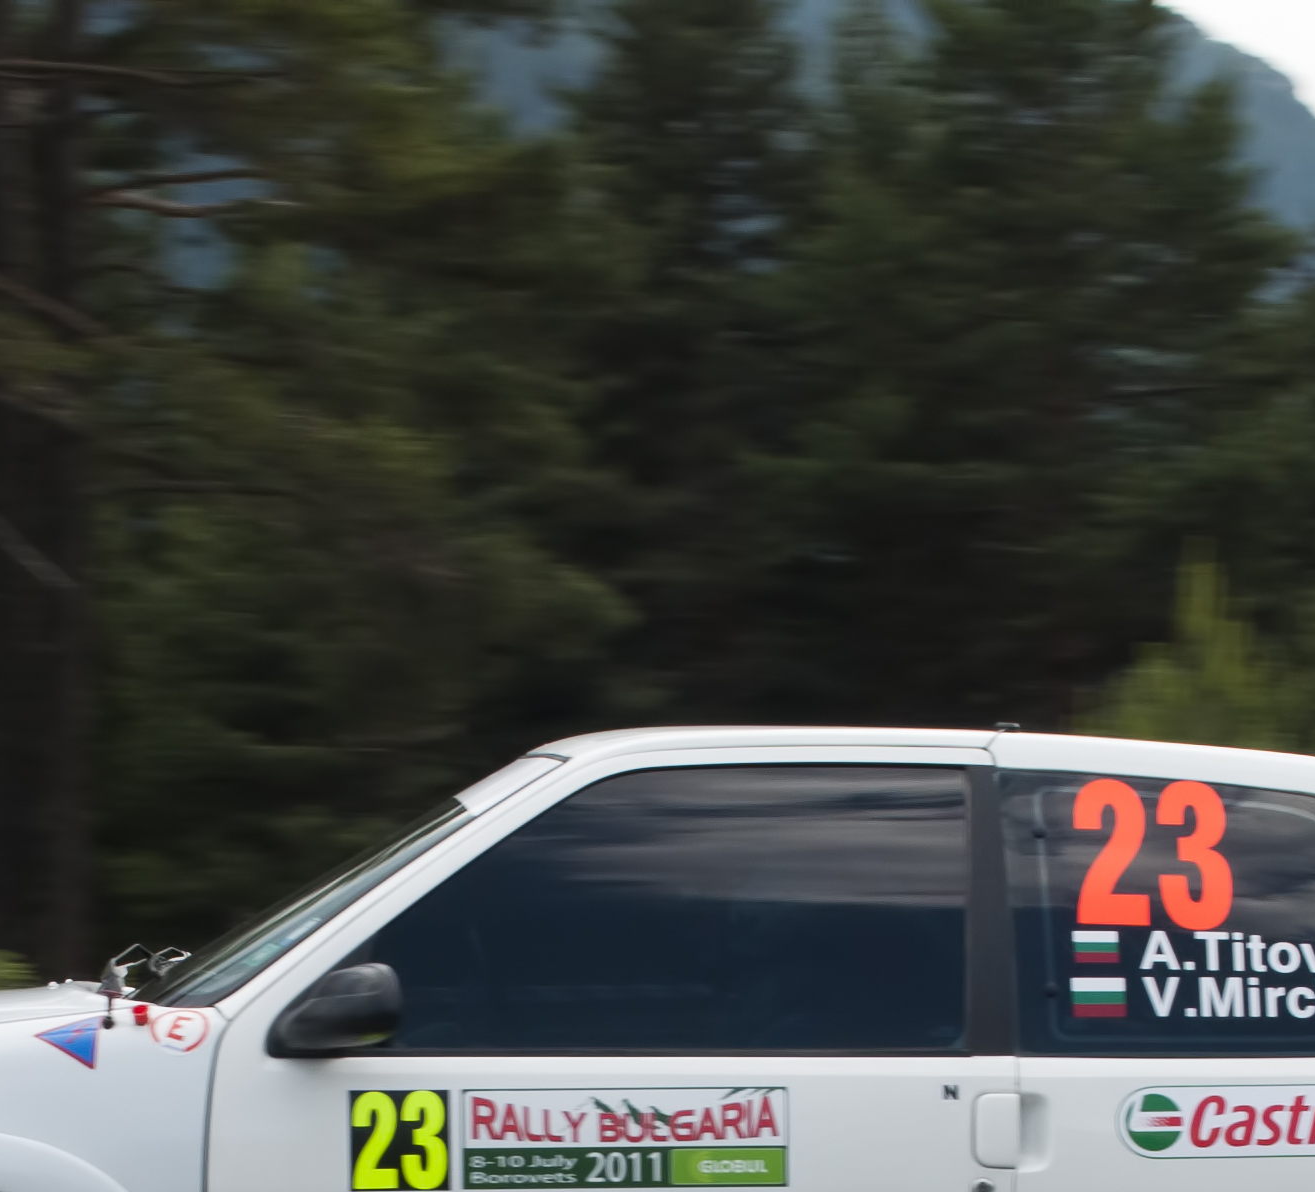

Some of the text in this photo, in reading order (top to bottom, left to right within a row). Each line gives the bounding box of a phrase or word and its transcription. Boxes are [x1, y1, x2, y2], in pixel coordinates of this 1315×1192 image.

[1072, 778, 1234, 930] 23
[167, 1015, 194, 1041] E
[943, 1085, 959, 1100] N
[472, 1097, 588, 1143] RALLY
[351, 1089, 449, 1190] 23
[469, 1154, 578, 1170] 8-10 July
[585, 1151, 663, 1183] 2011
[698, 1159, 768, 1174] GLOBUL
[469, 1171, 578, 1184] Borovets
